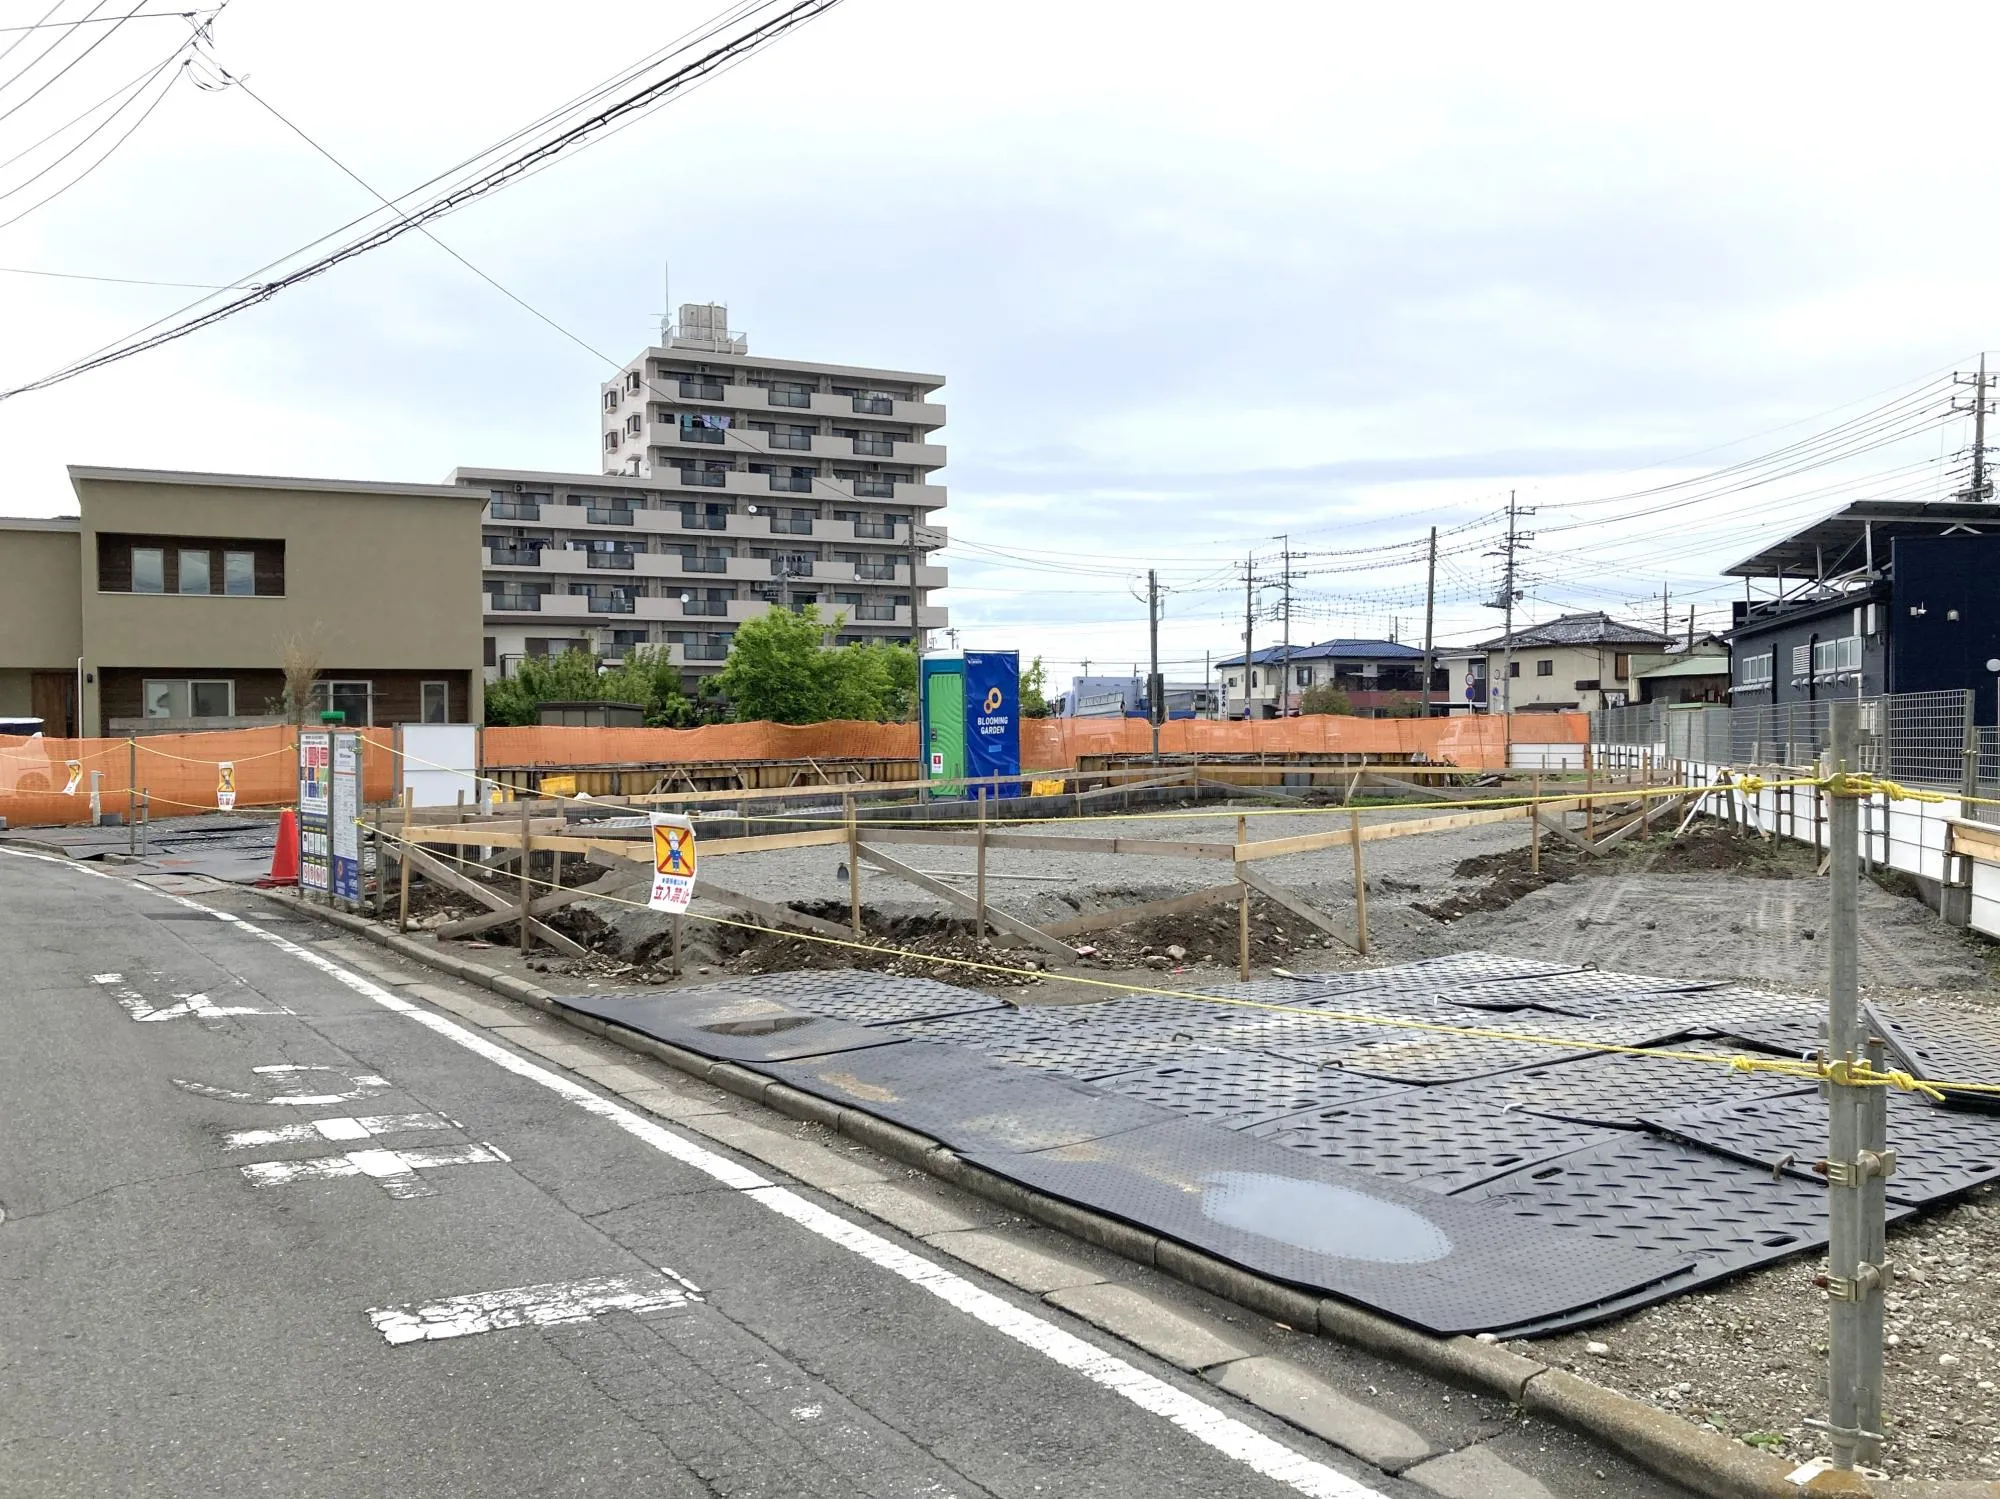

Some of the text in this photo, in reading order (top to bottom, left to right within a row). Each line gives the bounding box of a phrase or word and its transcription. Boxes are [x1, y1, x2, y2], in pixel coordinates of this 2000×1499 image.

[977, 716, 1008, 726] BLOOMING
[980, 726, 1005, 735] GARDEN
[655, 886, 689, 904] 立入禁止
